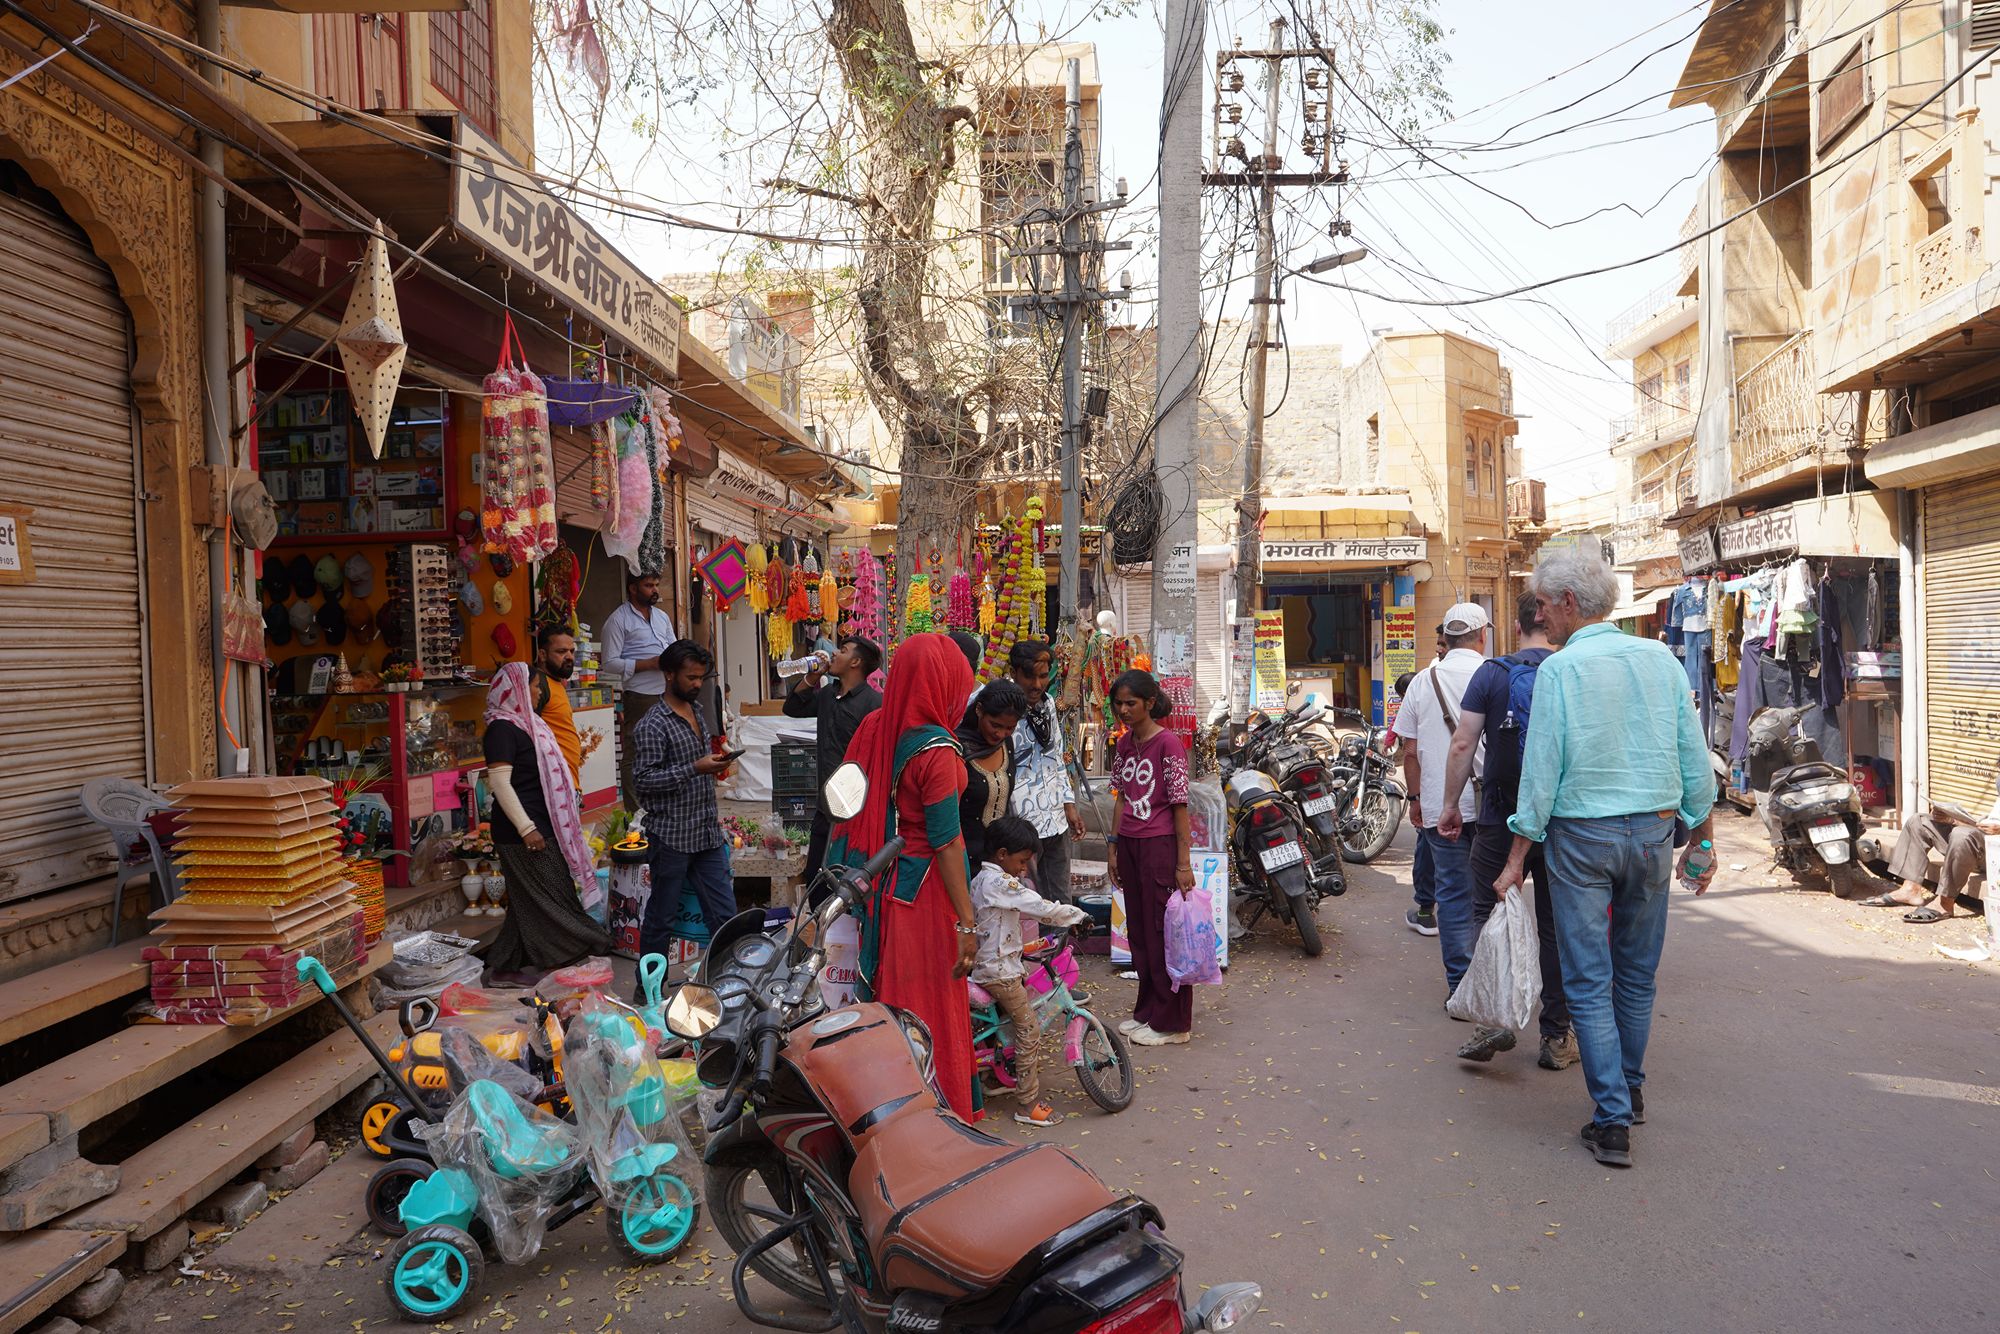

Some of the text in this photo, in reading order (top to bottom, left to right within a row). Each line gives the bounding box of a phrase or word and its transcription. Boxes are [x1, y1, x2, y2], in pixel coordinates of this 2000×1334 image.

[573, 232, 621, 320] वॉच
[622, 281, 632, 327] &
[1264, 541, 1337, 558] भगवती
[1721, 527, 1744, 552] कोमल
[1172, 546, 1191, 557] जन
[1269, 843, 1295, 858] RJ26S
[825, 965, 860, 985] CHA
[887, 1308, 940, 1330] Shine
